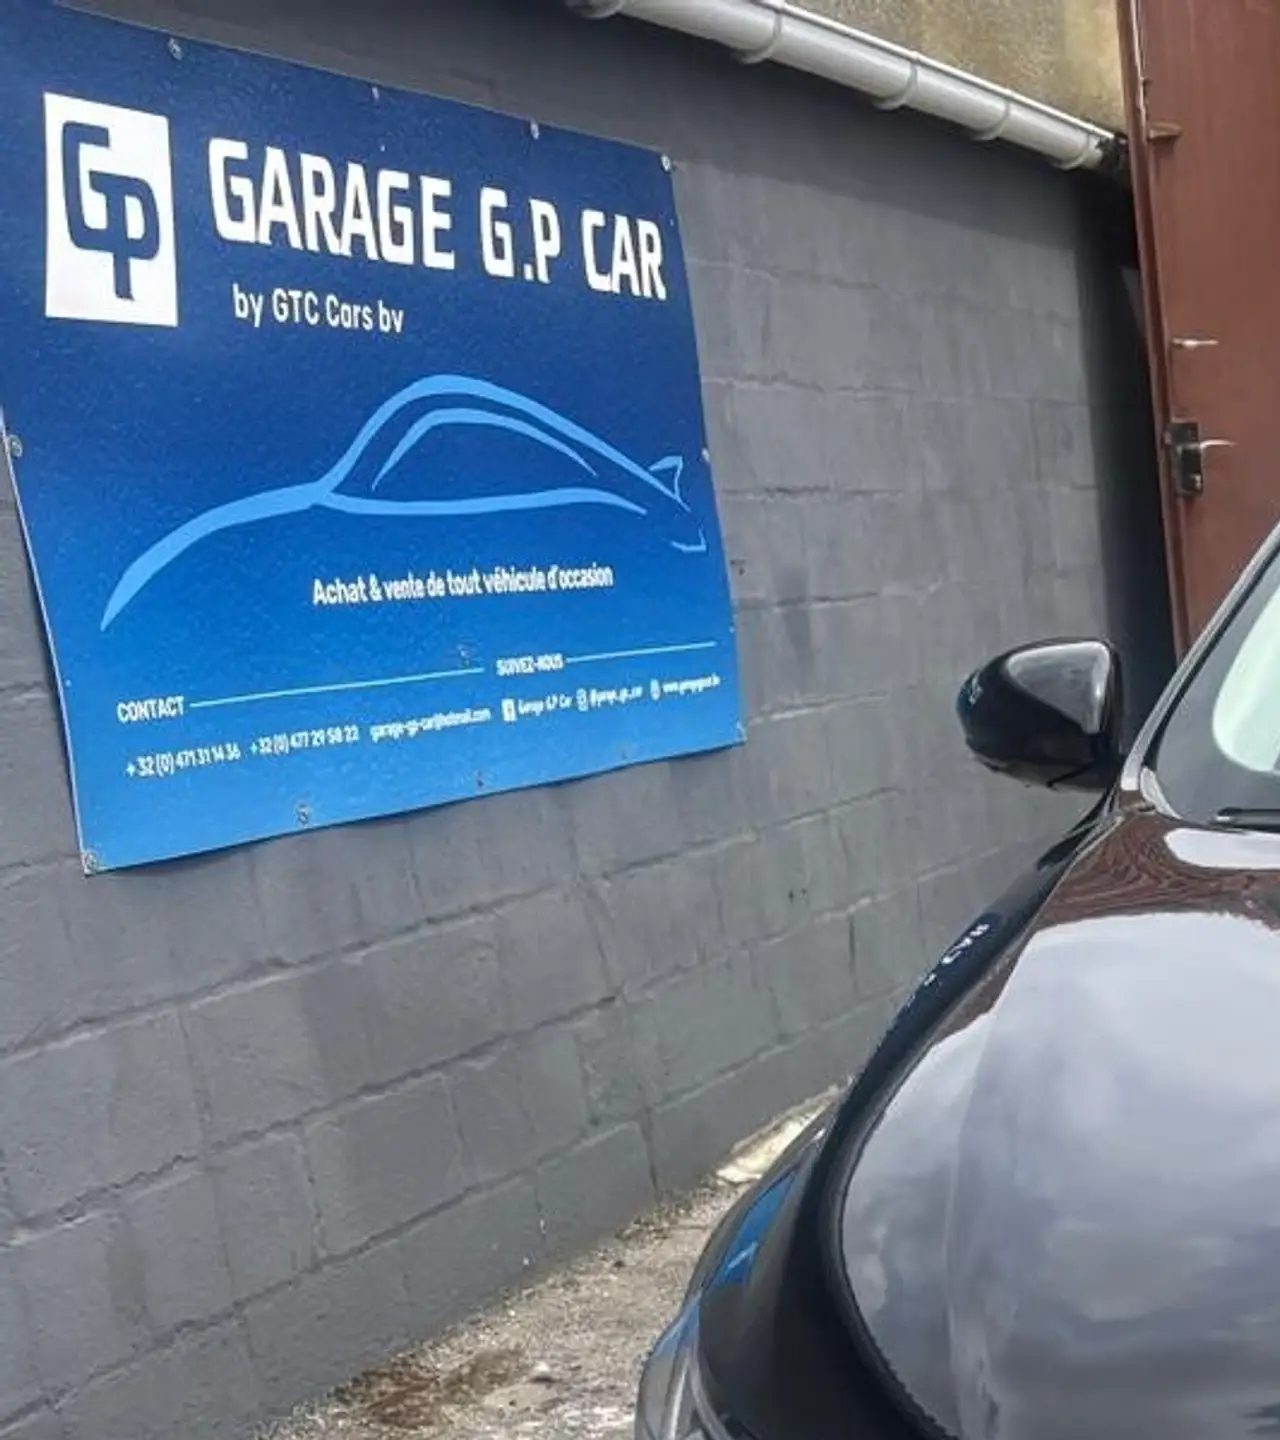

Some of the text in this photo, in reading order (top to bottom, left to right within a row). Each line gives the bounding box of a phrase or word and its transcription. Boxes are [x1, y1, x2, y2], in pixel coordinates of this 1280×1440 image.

[208, 136, 667, 300] GARAGE G.P CAR
[232, 282, 405, 333] by GTC Cars bv
[311, 575, 368, 606] Achat
[369, 573, 383, 602] &
[383, 569, 427, 601] vente
[427, 570, 446, 598] de
[446, 566, 482, 596] tout
[482, 565, 546, 594] véhicule
[116, 695, 185, 724] CONTACT
